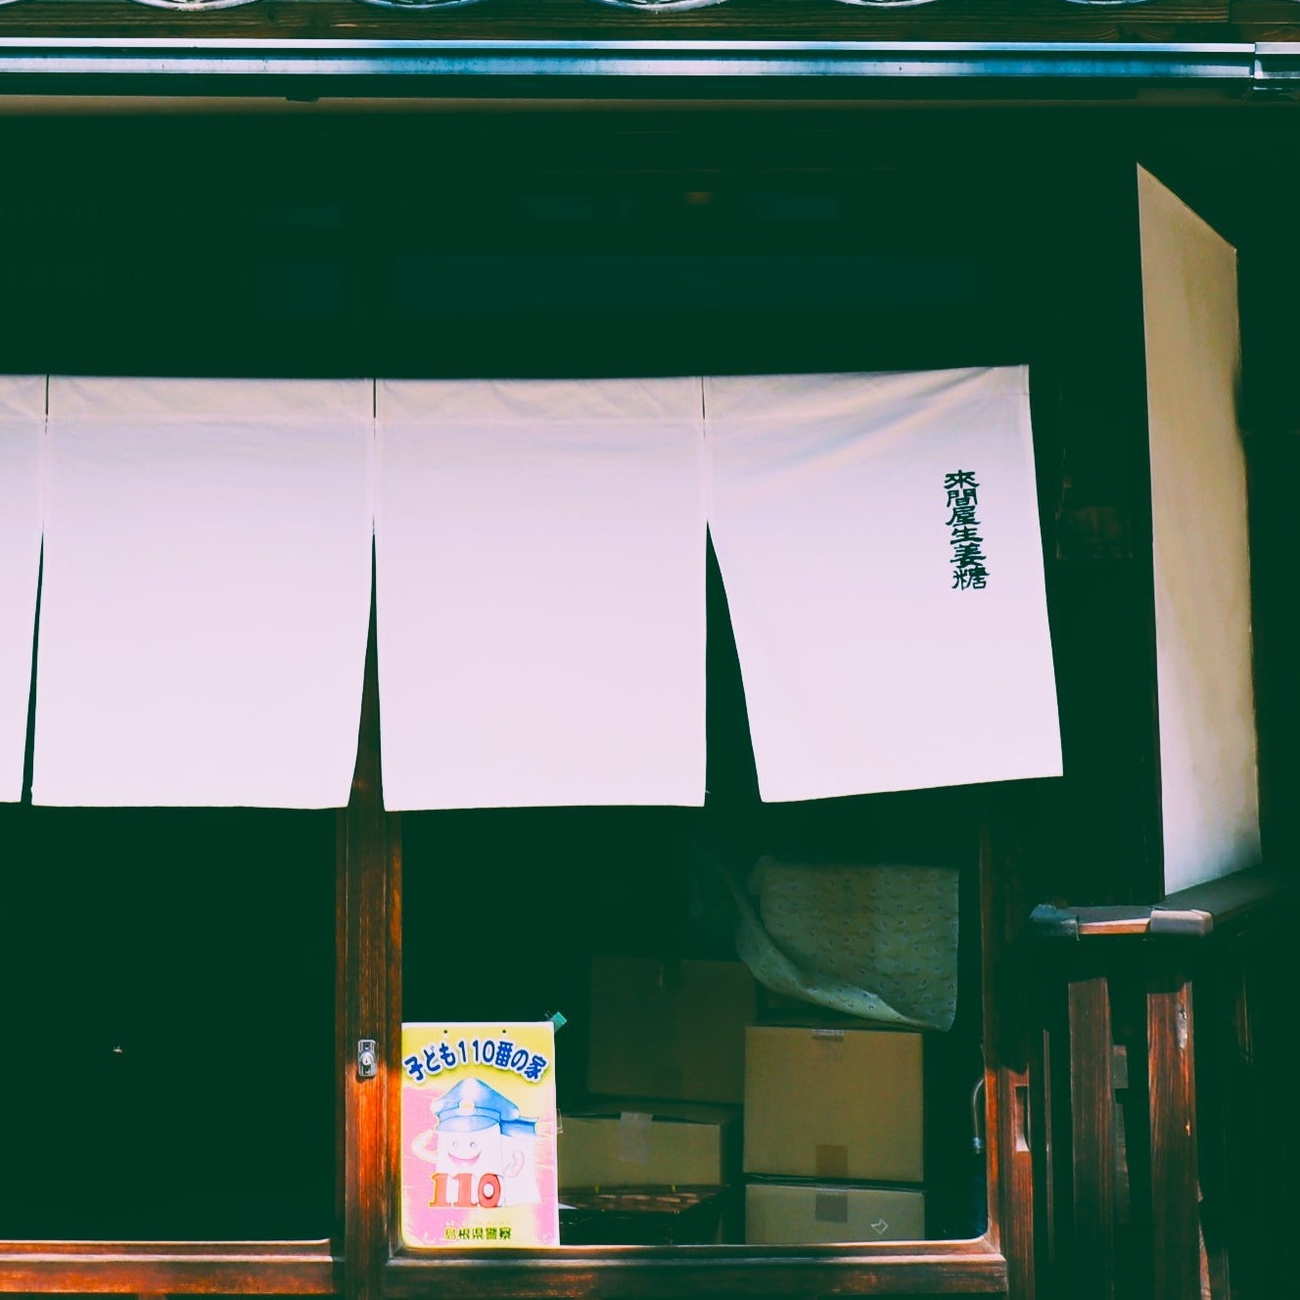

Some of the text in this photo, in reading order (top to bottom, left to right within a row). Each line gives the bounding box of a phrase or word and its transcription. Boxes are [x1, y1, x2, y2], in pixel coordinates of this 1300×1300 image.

[404, 1040, 547, 1080] 子ども110番の家
[428, 1172, 503, 1208] 110
